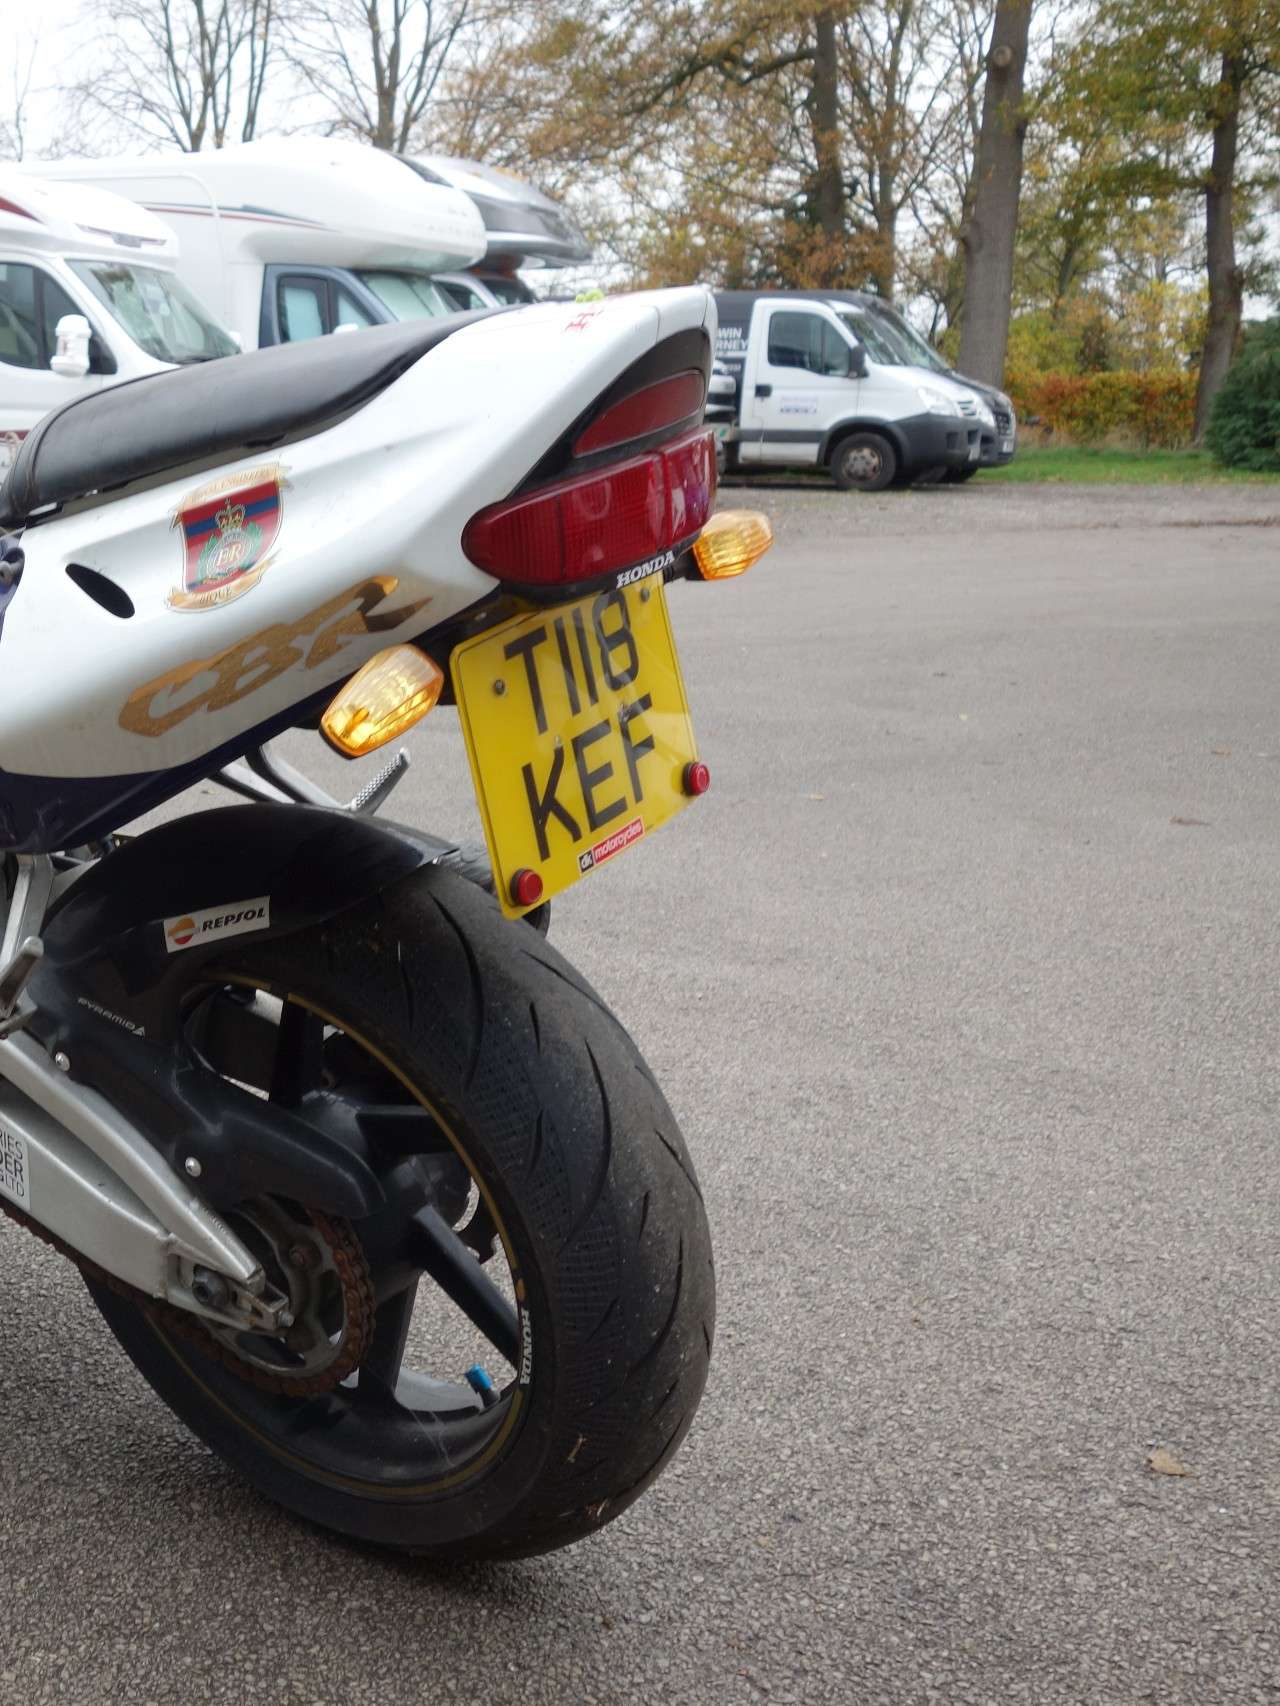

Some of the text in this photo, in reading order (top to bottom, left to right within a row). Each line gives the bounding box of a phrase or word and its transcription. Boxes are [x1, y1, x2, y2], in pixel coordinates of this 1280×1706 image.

[616, 551, 675, 589] HONDA
[118, 575, 432, 737] CBR
[504, 591, 639, 735] T118
[521, 693, 656, 862] KEF
[594, 822, 642, 860] motorcycles
[202, 908, 265, 932] REPSOL
[520, 1307, 532, 1385] HONDA
